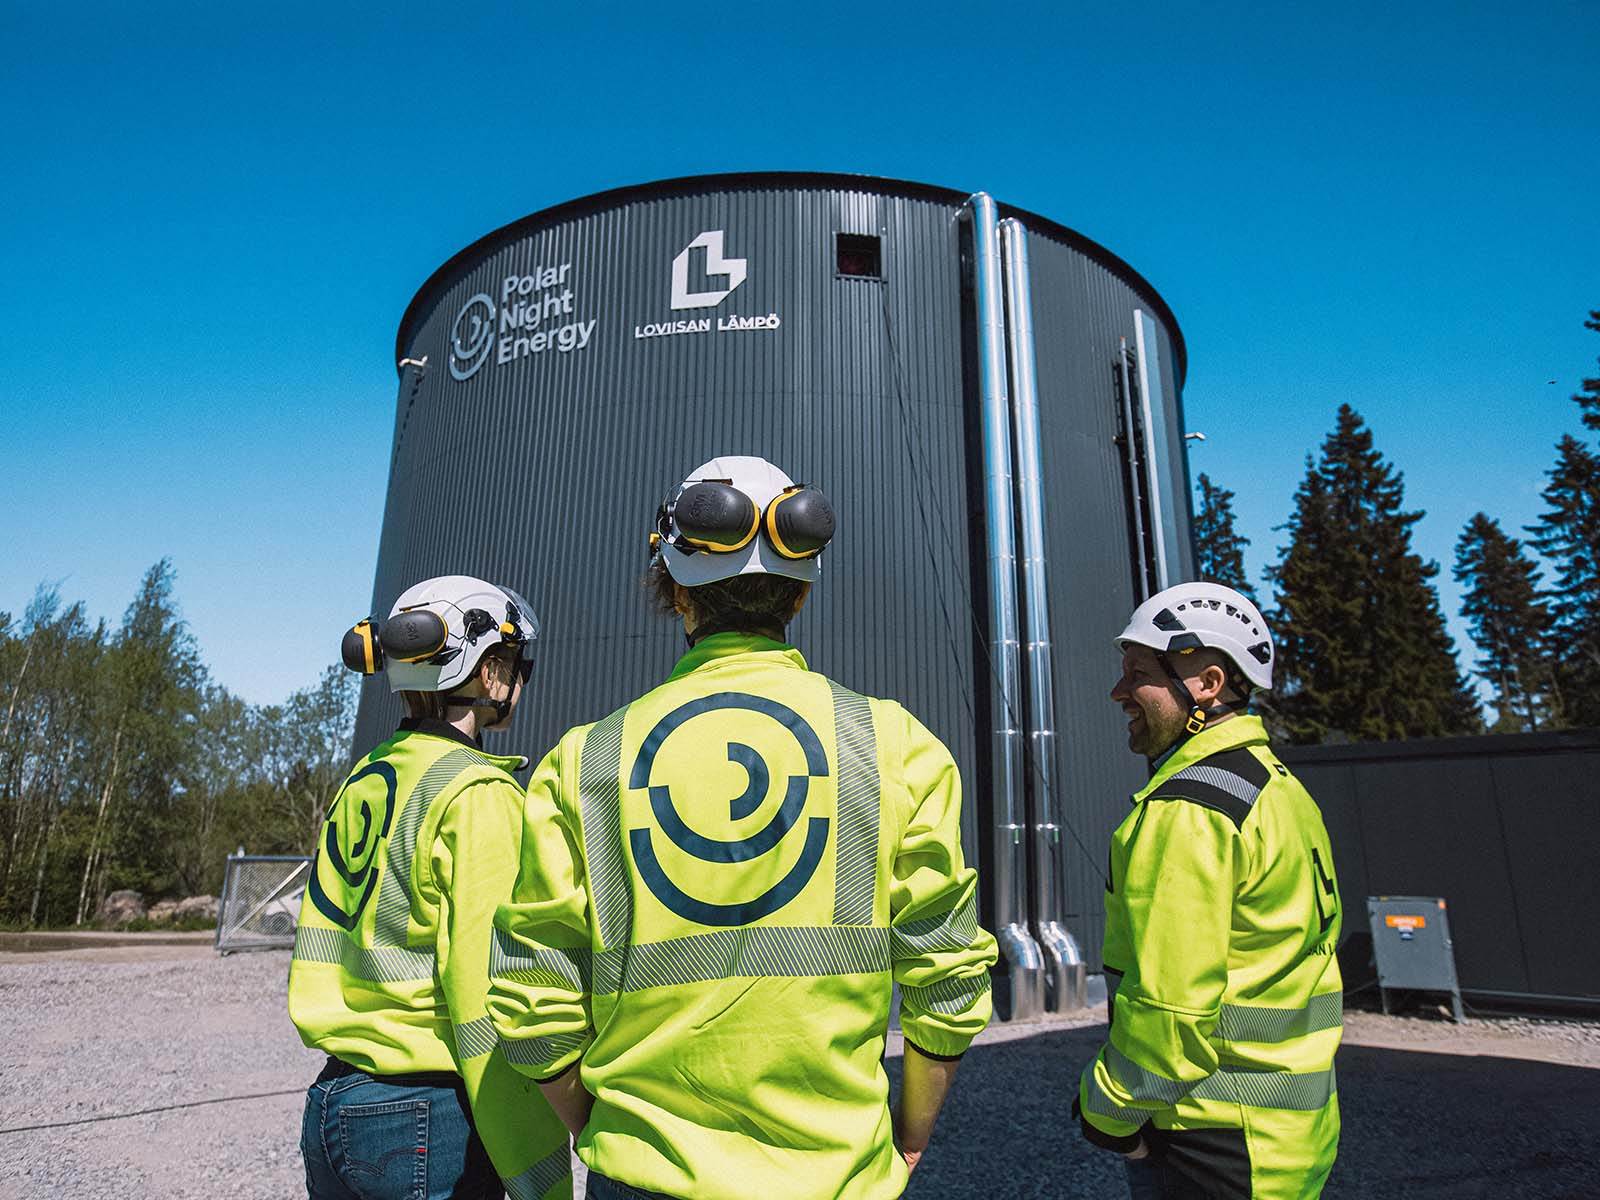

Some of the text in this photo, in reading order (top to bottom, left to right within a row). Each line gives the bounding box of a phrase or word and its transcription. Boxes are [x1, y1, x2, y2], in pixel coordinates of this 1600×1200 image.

[502, 262, 571, 301] Polar
[501, 290, 574, 334] Night
[634, 313, 781, 339] LOVIISAN LÄMPÖ
[497, 318, 596, 365] Energy
